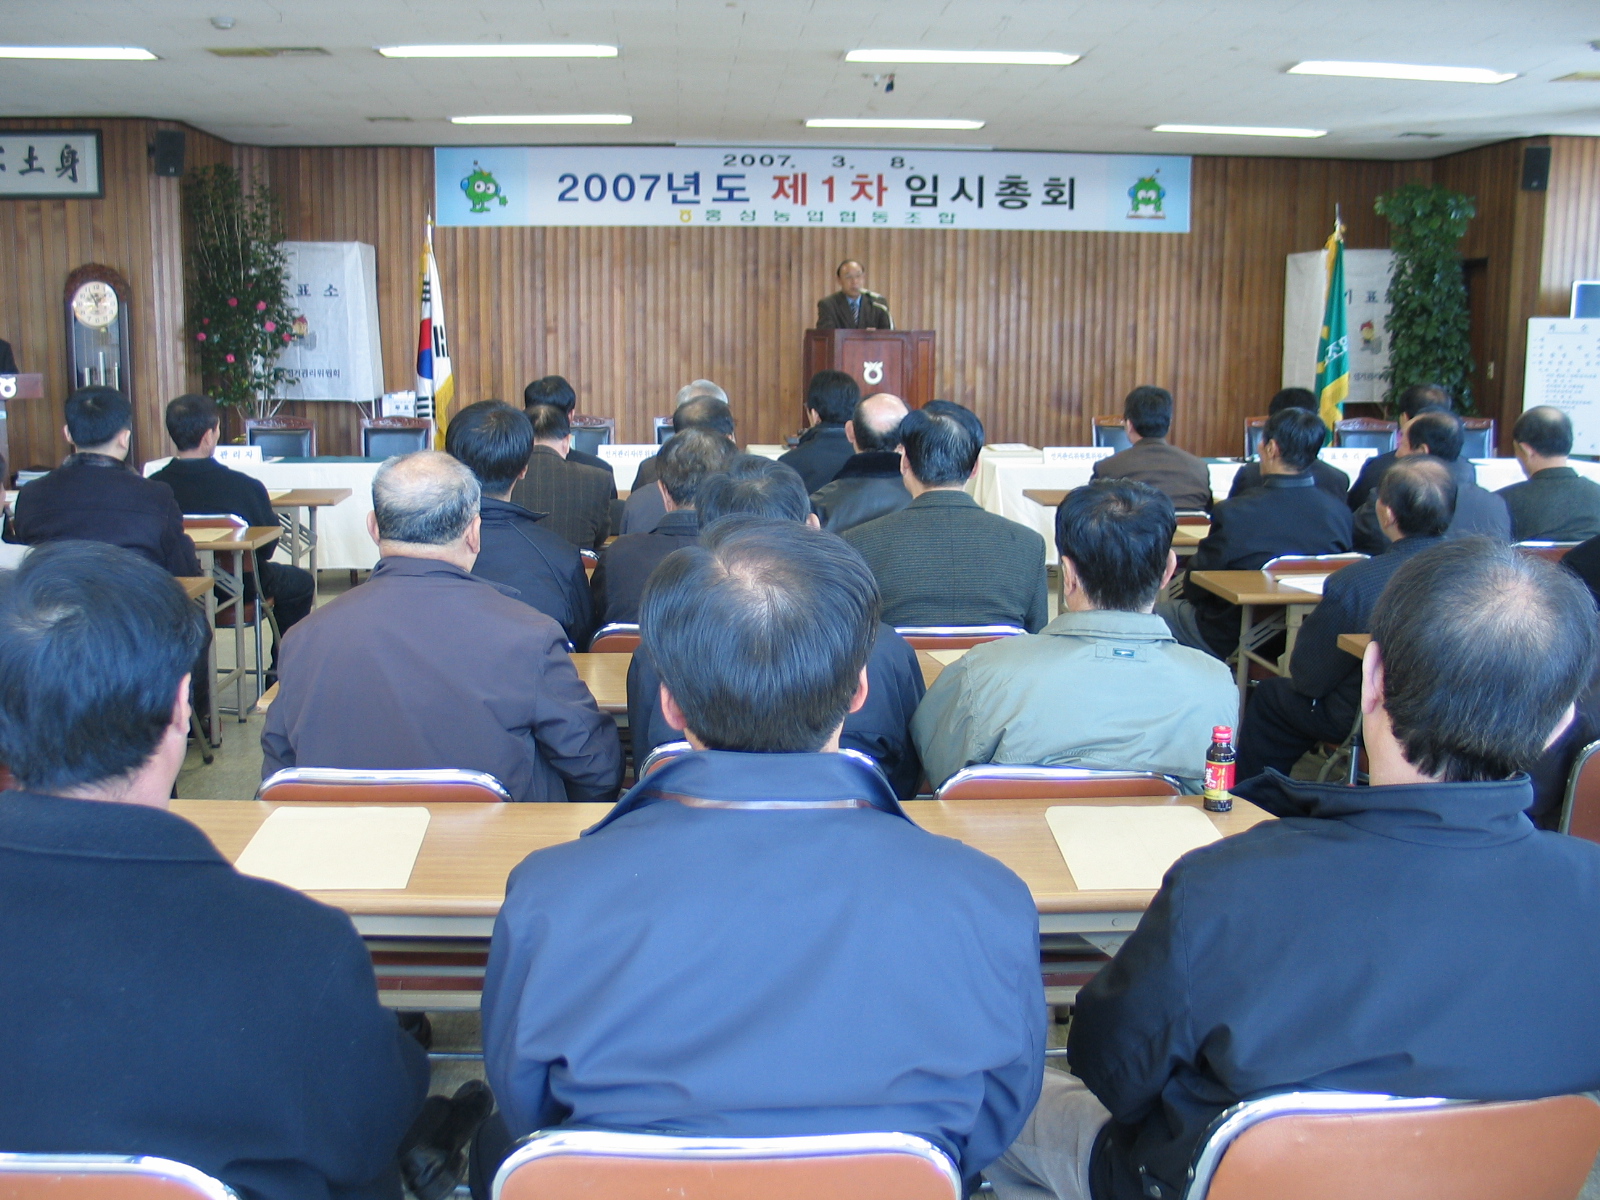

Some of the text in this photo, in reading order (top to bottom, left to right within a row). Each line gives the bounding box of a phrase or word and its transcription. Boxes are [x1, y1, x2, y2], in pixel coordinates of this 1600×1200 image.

[723, 153, 915, 170] 2007. 3. 8.
[557, 170, 1076, 210] 2007년도 제1차 임시총회
